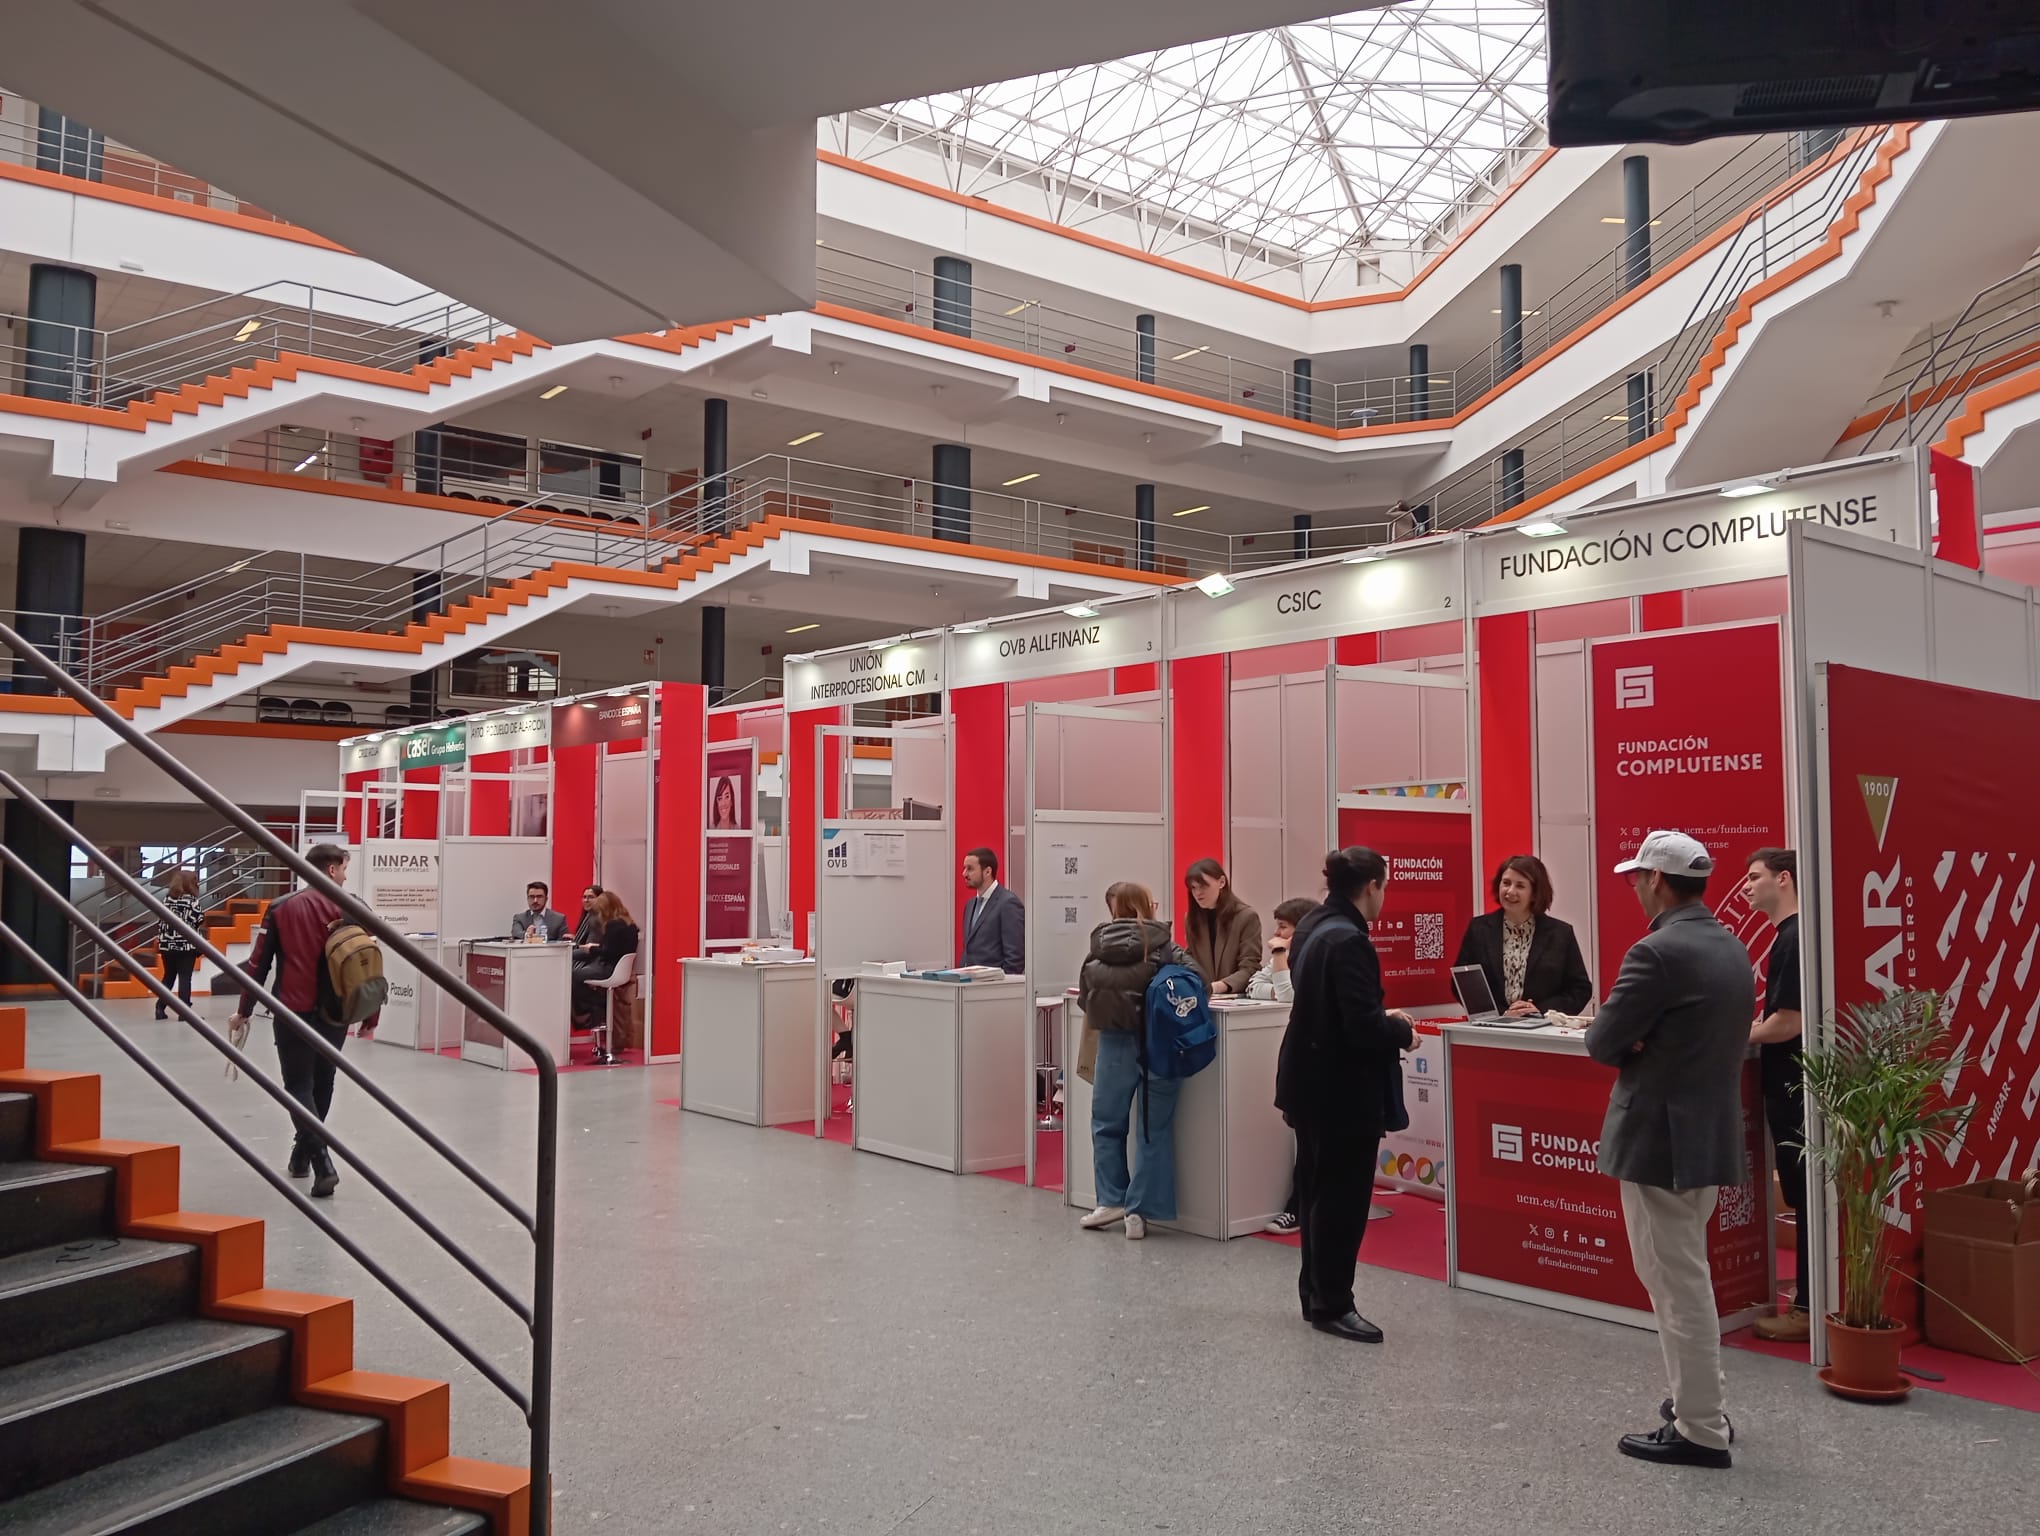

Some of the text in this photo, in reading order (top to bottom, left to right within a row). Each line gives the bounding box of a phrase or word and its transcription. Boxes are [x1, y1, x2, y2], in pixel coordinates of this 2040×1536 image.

[1500, 495, 1877, 579] FUNDACIÓN COMPLUTENSE
[1890, 528, 1896, 542] 1
[1277, 589, 1322, 614] CSIC
[1444, 596, 1452, 608] 2
[1000, 626, 1100, 658] OVB ALLFINANZ
[1146, 641, 1153, 651] 3
[849, 651, 883, 673] UNIÓN
[811, 669, 926, 700] INTERPROFESIONAL CM
[934, 673, 938, 681] 4
[406, 736, 433, 760] caser
[431, 744, 446, 757] Grupo
[1617, 735, 1709, 754] FUNDACIÓN
[1616, 753, 1763, 777] COMPLUTENSE
[1864, 781, 1890, 797] 1900
[1684, 824, 1769, 835] ucm.es/fundacion
[372, 854, 429, 867] INNPAR
[827, 859, 848, 868] OVB
[1393, 856, 1443, 869] FUNDACIÓN
[1393, 871, 1443, 881] COMPLUTENSE
[390, 982, 414, 998] Pozuelo
[1986, 1081, 2012, 1141] AMBAR
[1530, 1132, 1601, 1157] FUNDAC
[1531, 1152, 1601, 1175] COMPLU
[1516, 1192, 1618, 1219] ucm.es/fundacion
[1521, 1239, 1615, 1265] @fundacioncomplutense
[1537, 1255, 1599, 1276] @fundacionucm
